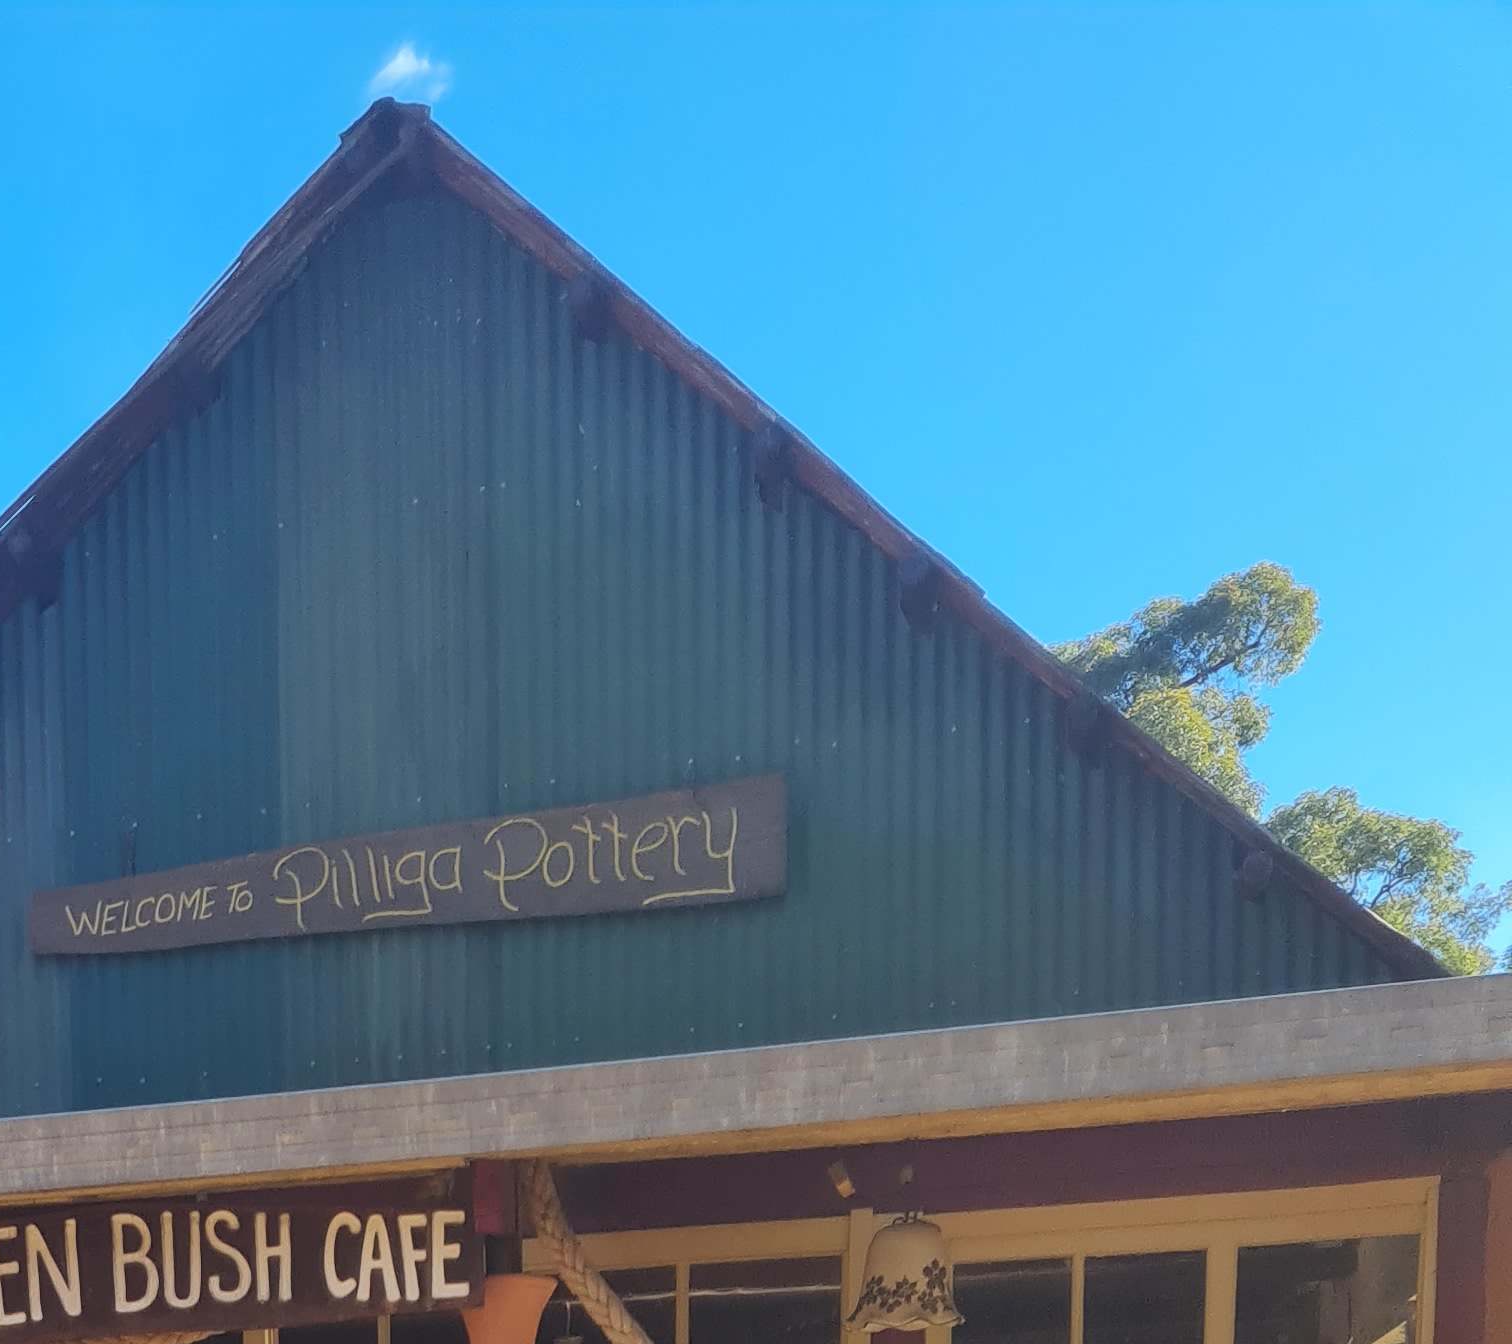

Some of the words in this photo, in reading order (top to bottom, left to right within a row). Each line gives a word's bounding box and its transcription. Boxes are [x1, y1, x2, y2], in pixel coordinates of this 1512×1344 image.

[65, 886, 218, 937] WELCOME
[273, 846, 463, 931] Pilliga
[483, 807, 738, 912] Pottery
[112, 1210, 293, 1313] BUSH
[323, 1210, 470, 1303] CAFE
